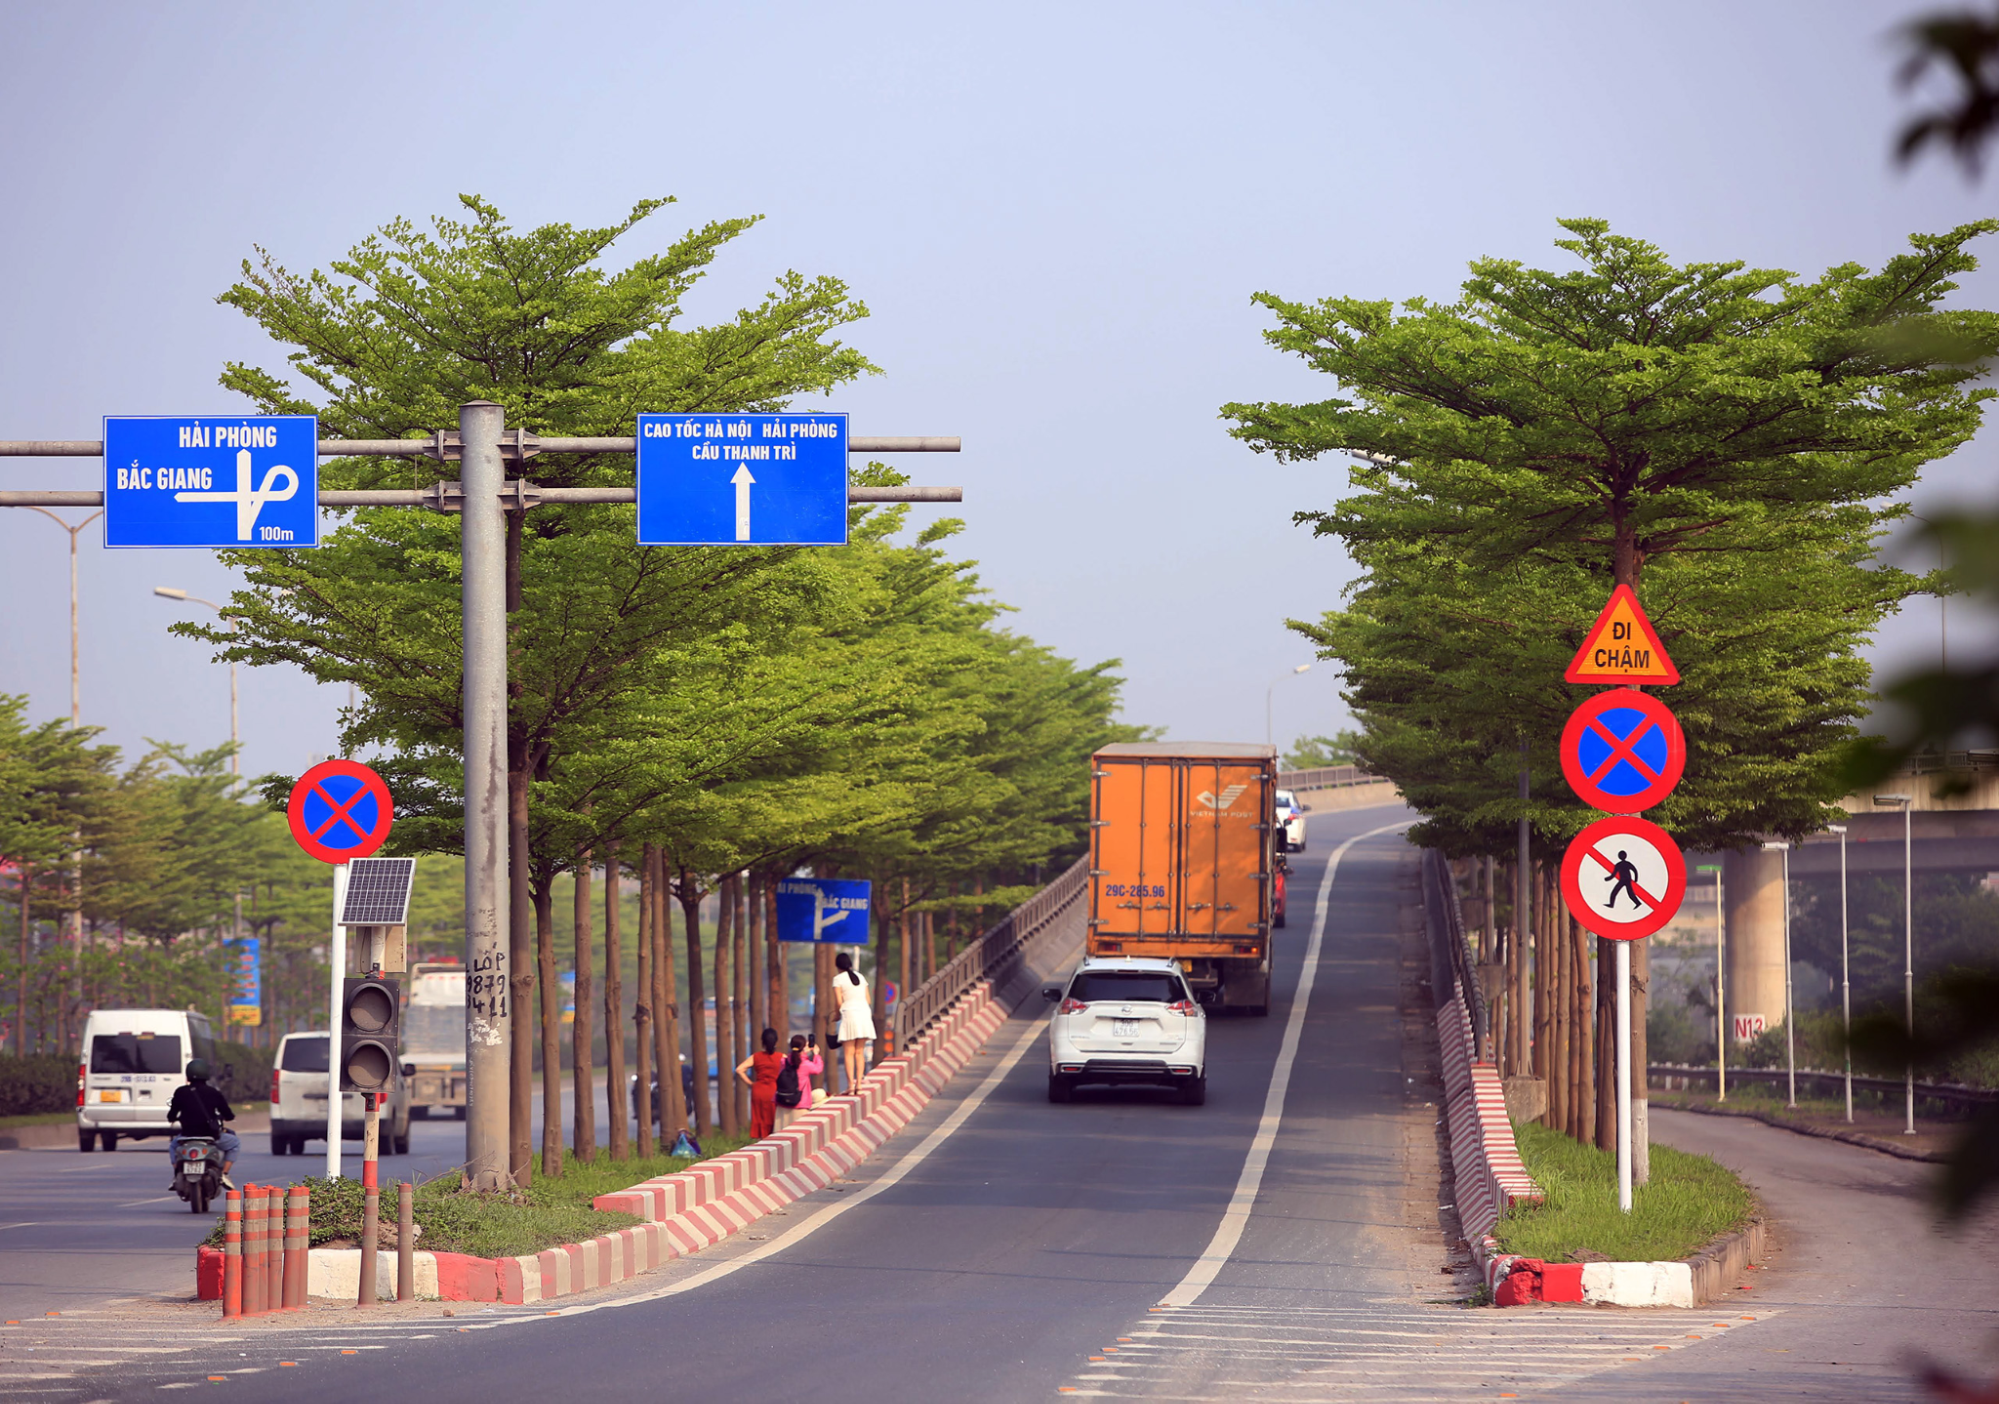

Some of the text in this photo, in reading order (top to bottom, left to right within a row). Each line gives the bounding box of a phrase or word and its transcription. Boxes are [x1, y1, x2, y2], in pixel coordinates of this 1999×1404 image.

[179, 420, 277, 448] HẢI PHÒNG
[644, 418, 838, 441] CAO TỐC HÀ NỘI HẢI PHÒNG
[692, 440, 796, 460] CẦU THANH TRÌ
[117, 459, 212, 490] BẮC GIANG
[259, 526, 294, 541] 100m
[1612, 622, 1631, 640] ĐI
[1595, 645, 1649, 673] CHẬM
[841, 897, 869, 910] GIANG
